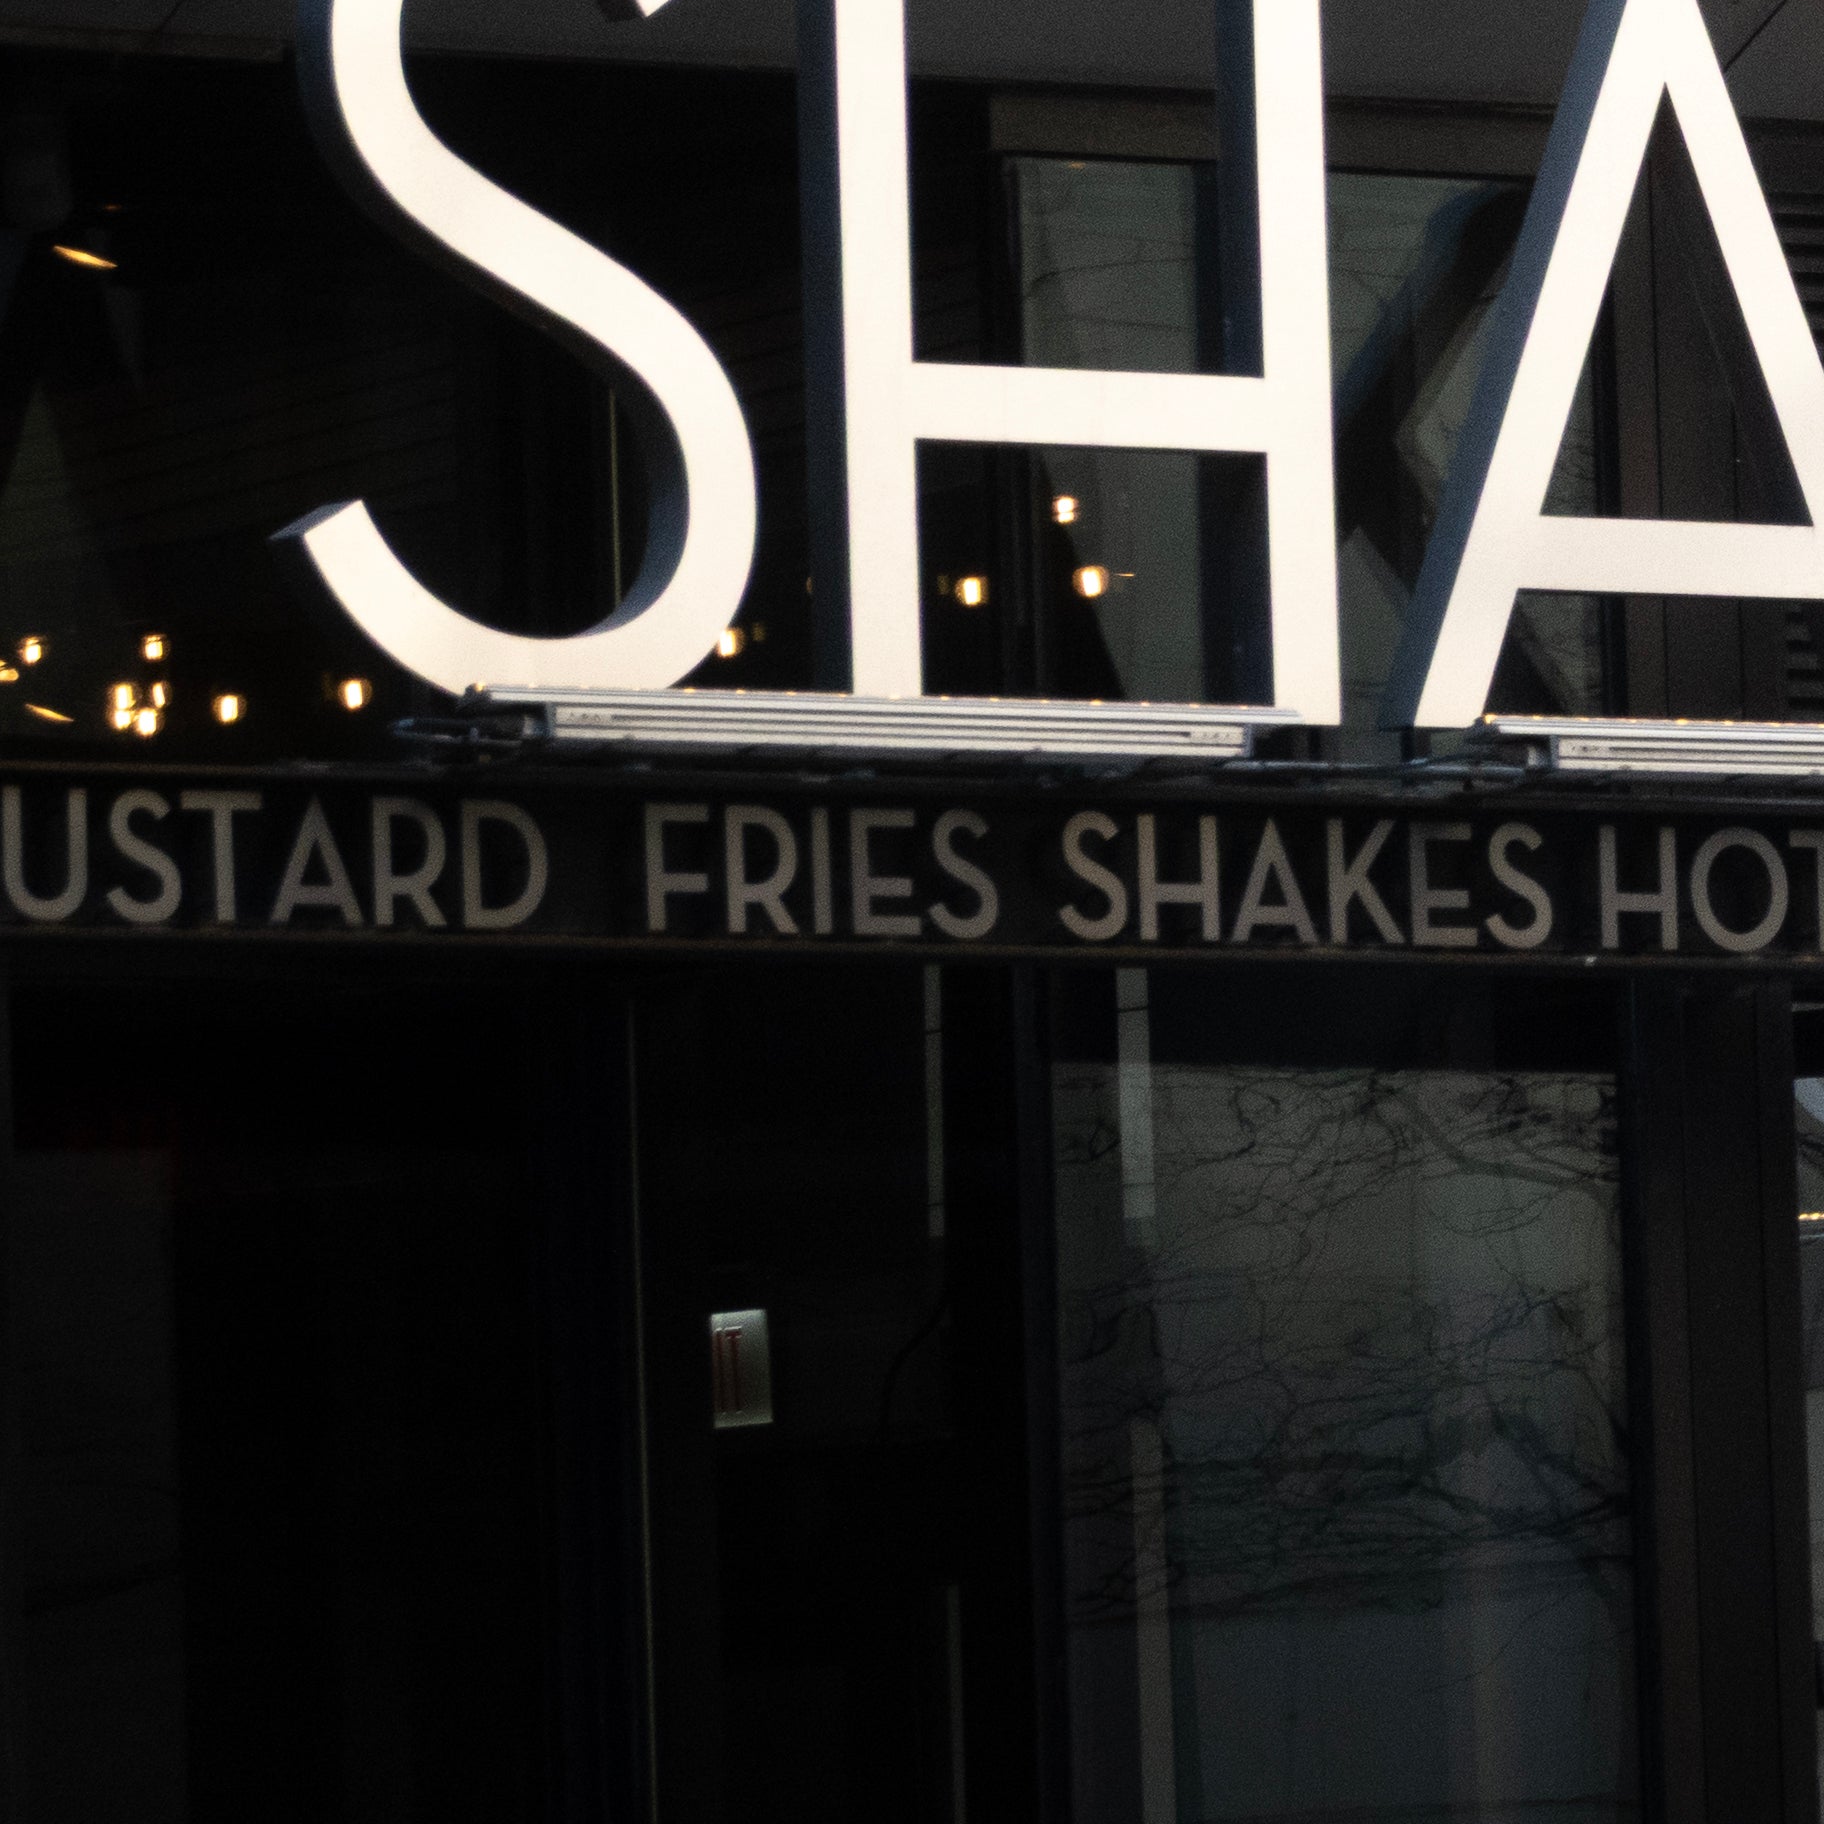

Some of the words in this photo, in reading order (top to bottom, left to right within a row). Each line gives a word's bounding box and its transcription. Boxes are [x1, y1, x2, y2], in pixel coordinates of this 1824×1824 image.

[2, 786, 549, 930] USTARD
[645, 803, 1000, 939] FRIES
[1058, 810, 1554, 950] SHAKES
